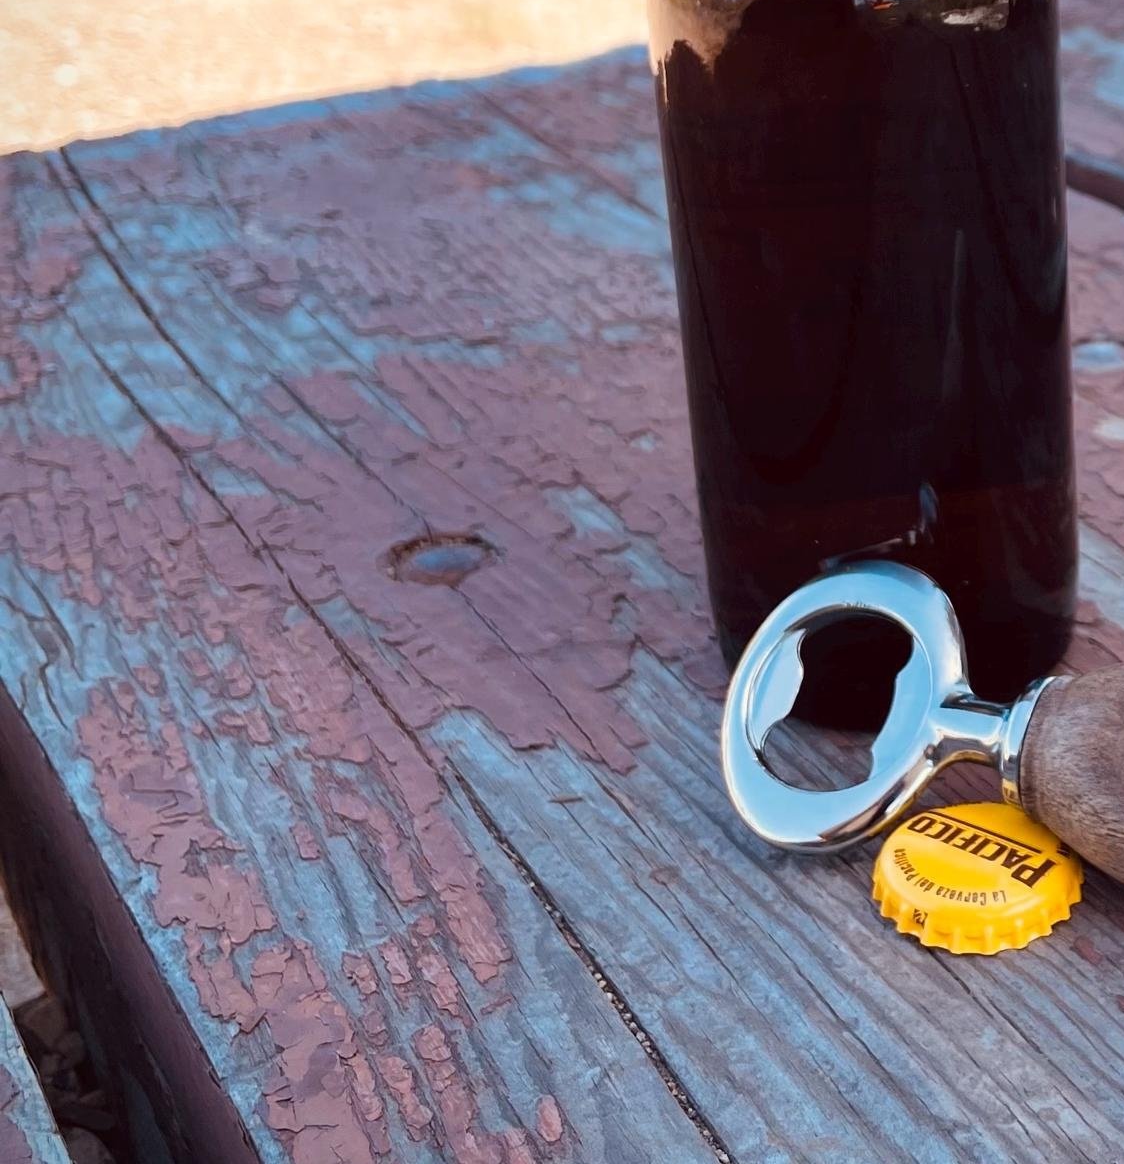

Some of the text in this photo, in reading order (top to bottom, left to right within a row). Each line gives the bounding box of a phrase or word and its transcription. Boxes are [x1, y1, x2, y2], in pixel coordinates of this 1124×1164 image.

[907, 815, 1057, 889] PACIFICO
[916, 873, 934, 891] del
[936, 888, 987, 906] Cerveza
[993, 889, 1007, 903] La
